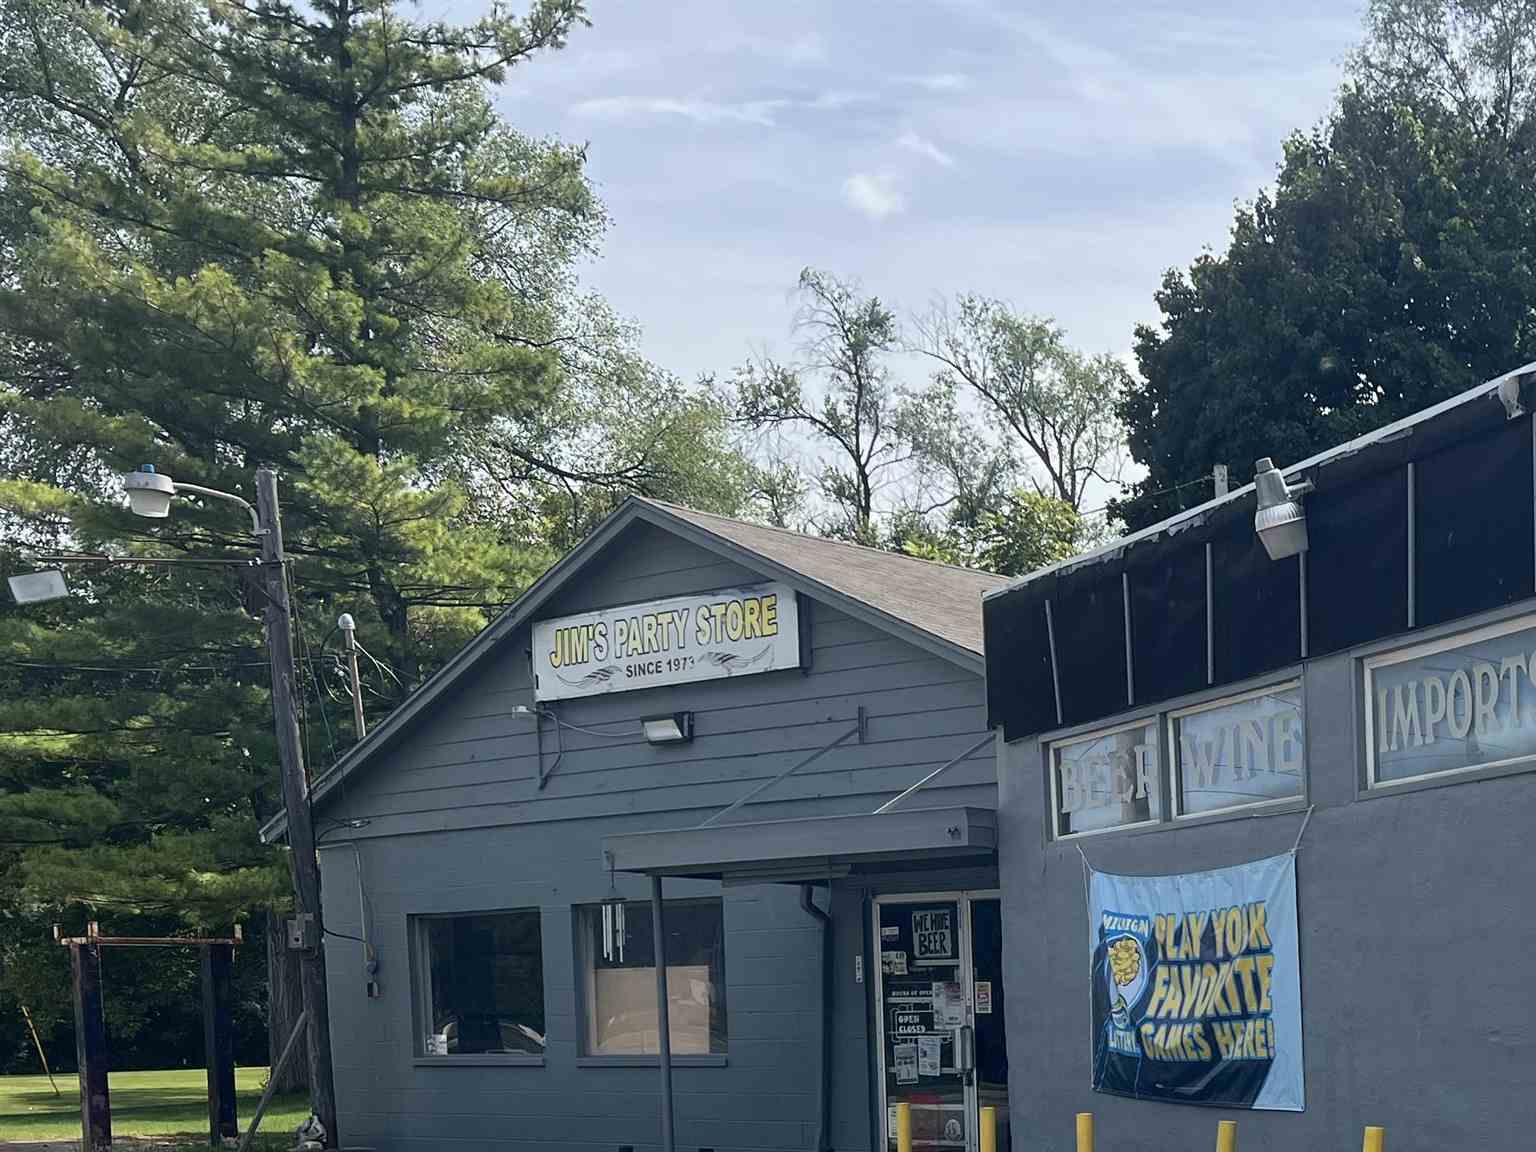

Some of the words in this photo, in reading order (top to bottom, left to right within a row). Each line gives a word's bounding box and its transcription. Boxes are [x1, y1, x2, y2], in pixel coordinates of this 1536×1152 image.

[550, 622, 609, 669] JIM'S
[614, 608, 690, 658] PARTY
[696, 593, 779, 646] STORE
[625, 657, 662, 678] SINCE
[1180, 709, 1300, 786] WINE
[913, 914, 930, 933] WE
[918, 932, 948, 956] BEER
[1154, 911, 1206, 962] PLAY
[1211, 900, 1273, 958] YOUR
[1146, 953, 1275, 1020] FAVORITE
[898, 1025, 926, 1034] CLOSED
[1139, 1021, 1212, 1062] GAMES
[1213, 1017, 1276, 1061] HERE!
